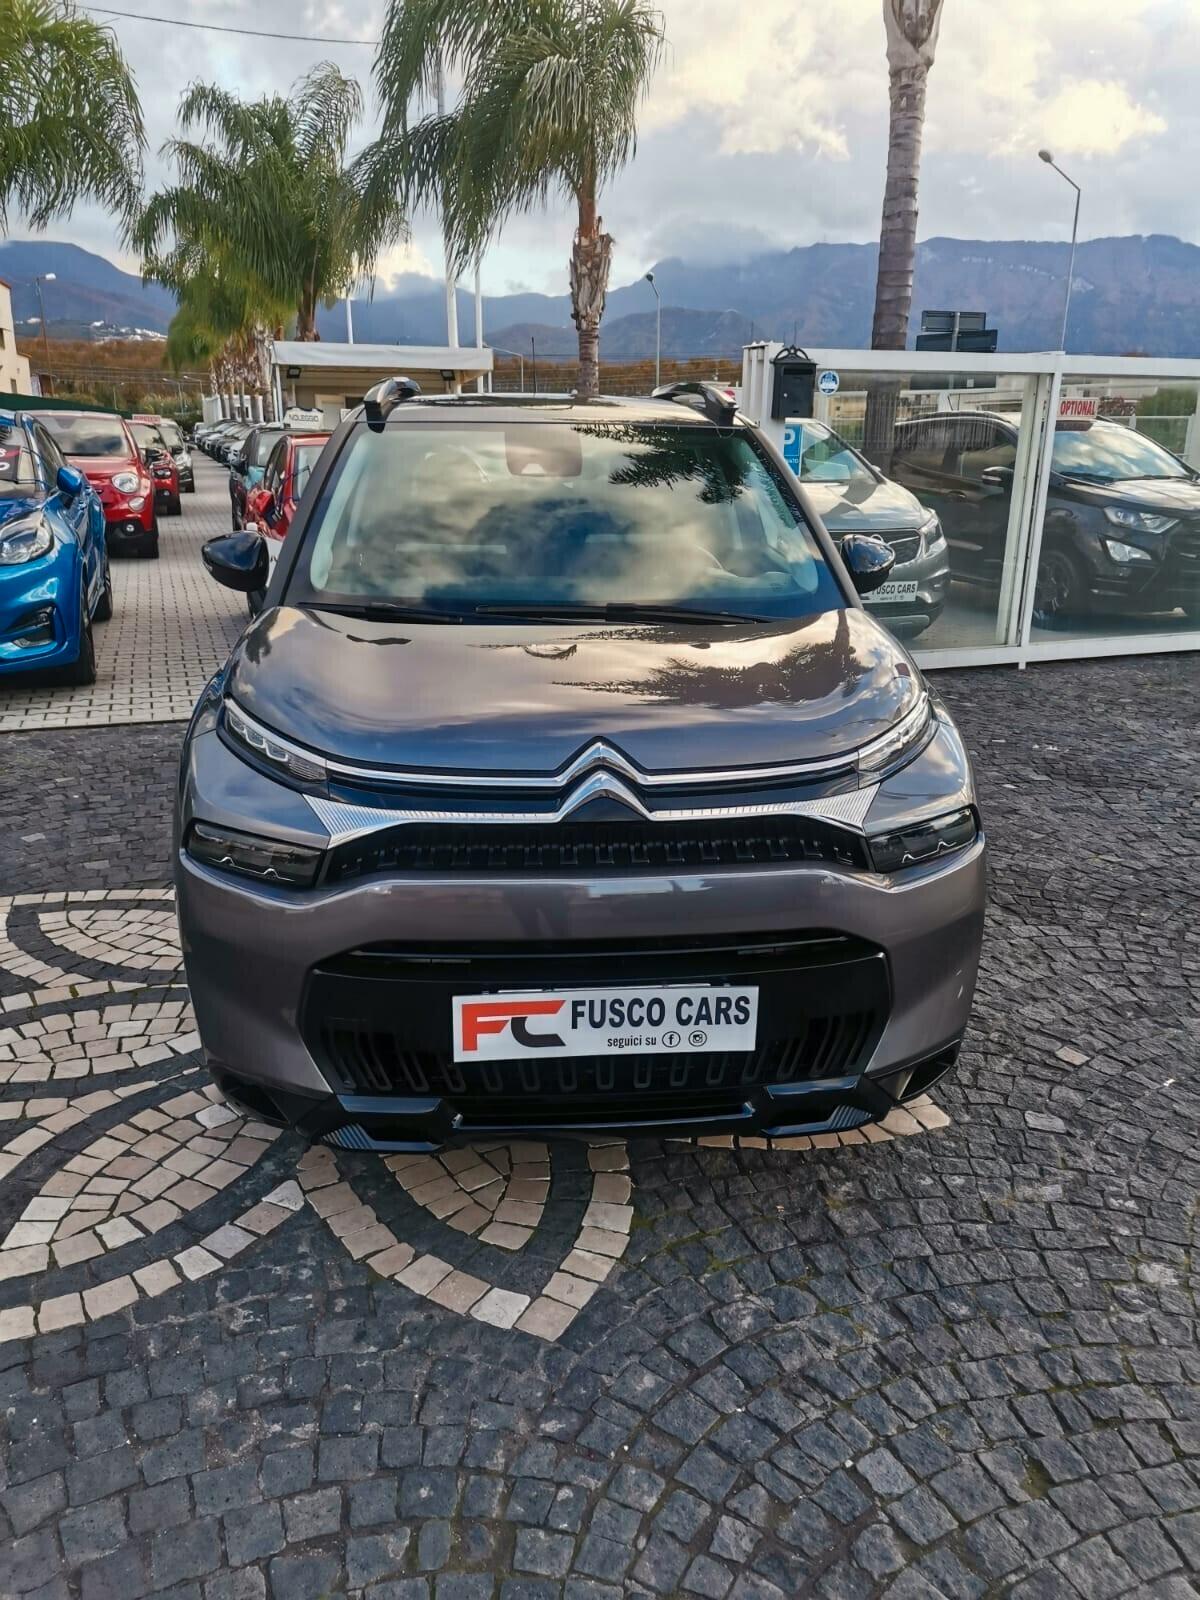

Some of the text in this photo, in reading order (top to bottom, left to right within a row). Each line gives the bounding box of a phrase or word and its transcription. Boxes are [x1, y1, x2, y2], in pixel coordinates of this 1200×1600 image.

[1060, 400, 1096, 416] OPTIONAL
[897, 583, 916, 593] CARS
[571, 995, 751, 1029] FUSCO CARS
[607, 1034, 643, 1047] seguici
[645, 1036, 657, 1046] su
